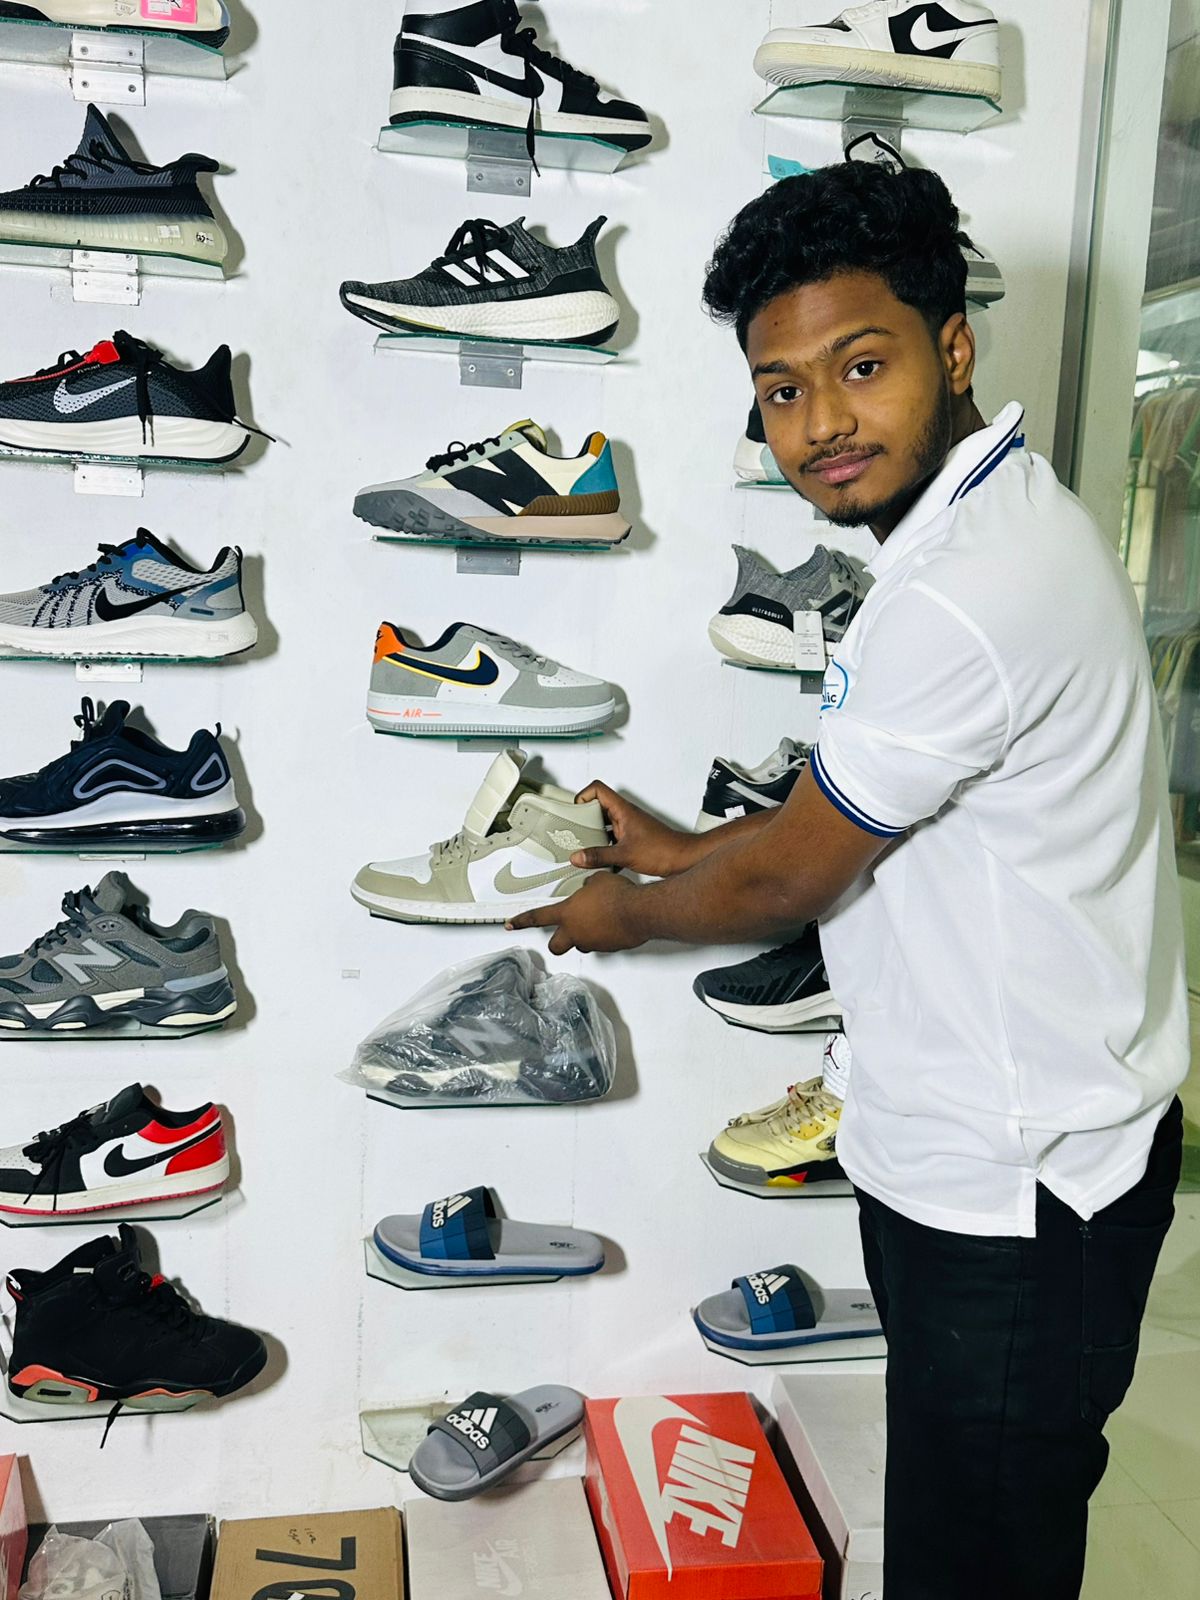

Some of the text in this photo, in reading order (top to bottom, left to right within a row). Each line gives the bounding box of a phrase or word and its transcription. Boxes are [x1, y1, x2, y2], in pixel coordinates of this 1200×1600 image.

[402, 708, 423, 718] AIR
[664, 1424, 757, 1548] NIKE
[473, 1551, 502, 1589] NIKE
